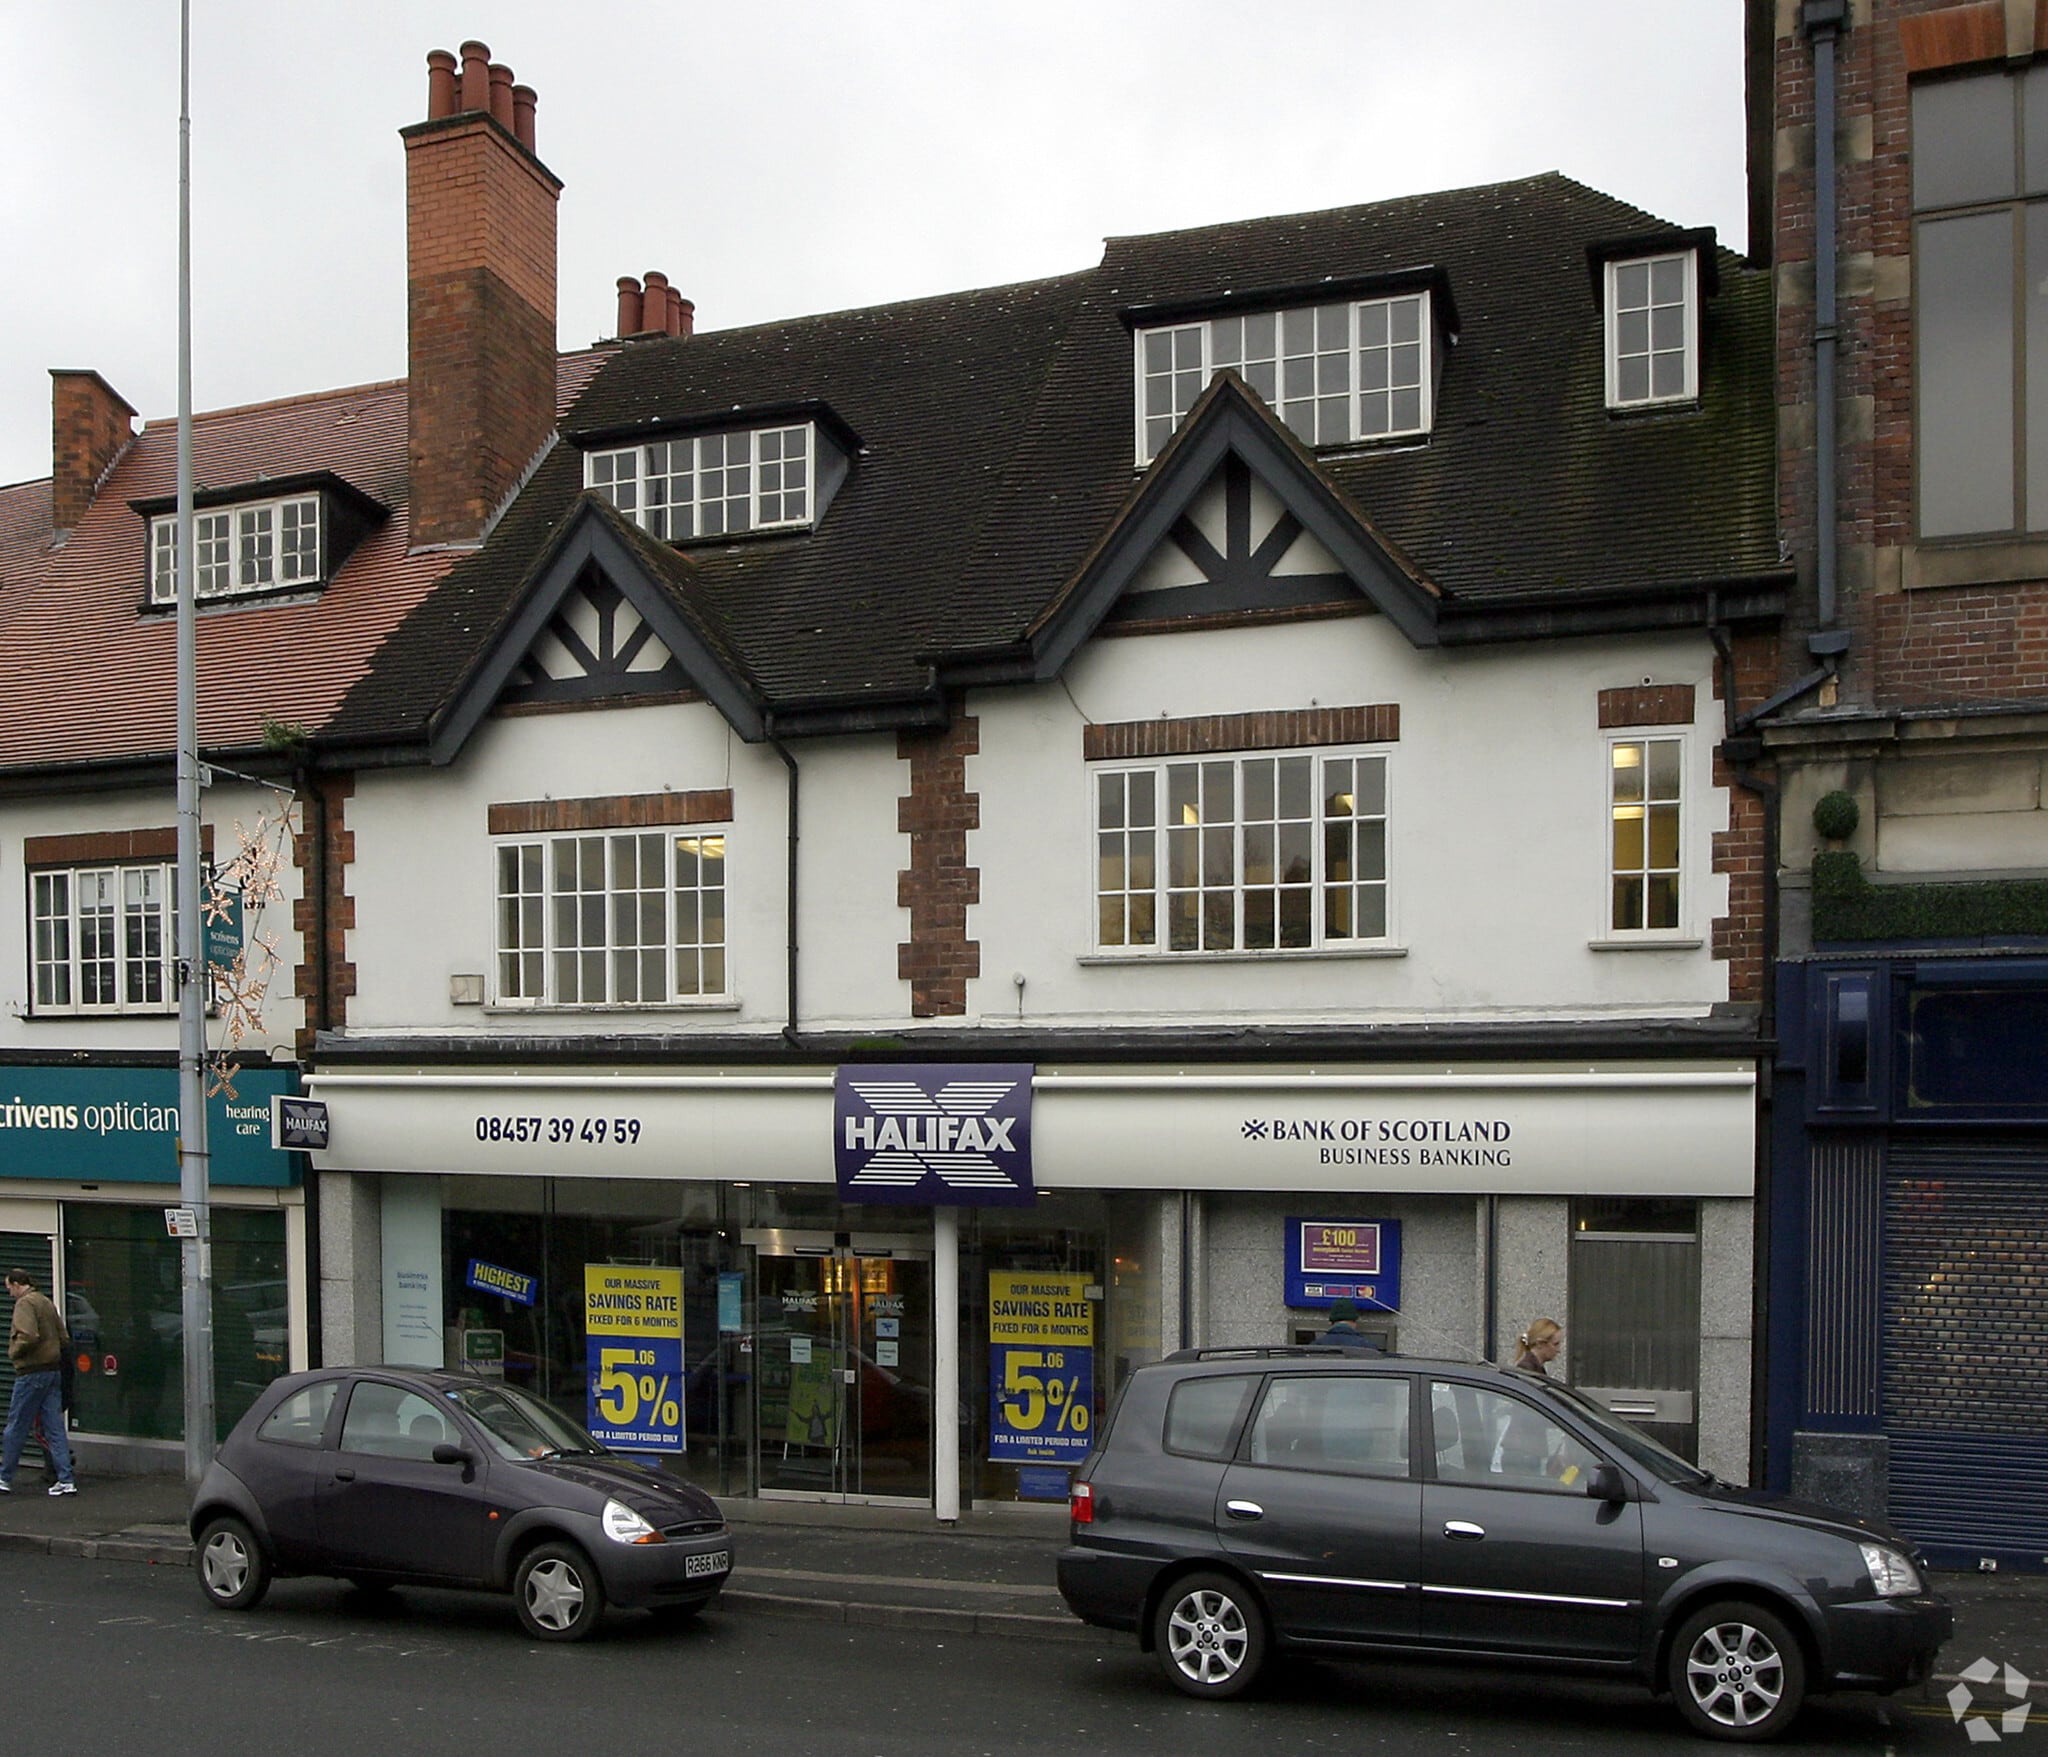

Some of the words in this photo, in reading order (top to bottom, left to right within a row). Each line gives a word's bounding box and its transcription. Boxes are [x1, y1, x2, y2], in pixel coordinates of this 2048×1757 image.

[210, 931, 240, 945] scrivens
[225, 1104, 271, 1122] hearing
[235, 1122, 261, 1136] care
[285, 1116, 328, 1133] HALIFAX
[475, 1116, 542, 1142] 08457
[548, 1117, 575, 1143] 39
[580, 1118, 608, 1144] 49
[613, 1118, 642, 1145] 59
[1273, 1120, 1335, 1142] BANK
[1340, 1120, 1372, 1142] OF
[1378, 1120, 1511, 1143] SCOTLAND
[845, 1116, 1017, 1152] HALIFAX
[1320, 1148, 1411, 1165] BUSINESS
[1419, 1148, 1511, 1167] BANKING
[1322, 1229, 1356, 1247] £100
[474, 1263, 530, 1294] HIGHEST
[604, 1278, 621, 1289] OUR
[624, 1279, 661, 1291] MASSIVE
[1010, 1284, 1028, 1295] OUR
[1031, 1285, 1071, 1297] MASSIVE
[589, 1293, 641, 1310] SAVINGS
[646, 1296, 678, 1312] RATE
[782, 1296, 818, 1306] HALIFAX
[993, 1300, 1050, 1317] SAVINGS
[1055, 1302, 1088, 1318] RATE
[589, 1314, 613, 1325] FIXED
[616, 1315, 632, 1326] FOR
[635, 1316, 640, 1326] 6
[642, 1317, 678, 1328] MONTHS
[993, 1322, 1019, 1334] FIXED
[1021, 1323, 1039, 1334] FOR
[1042, 1325, 1049, 1335] 6
[1051, 1325, 1089, 1336] MONTHS
[591, 1430, 604, 1439] FOR
[994, 1434, 1008, 1443] FOR
[1015, 1435, 1043, 1445] LIMITED
[687, 1555, 711, 1575] R266
[711, 1552, 727, 1571] KNR
